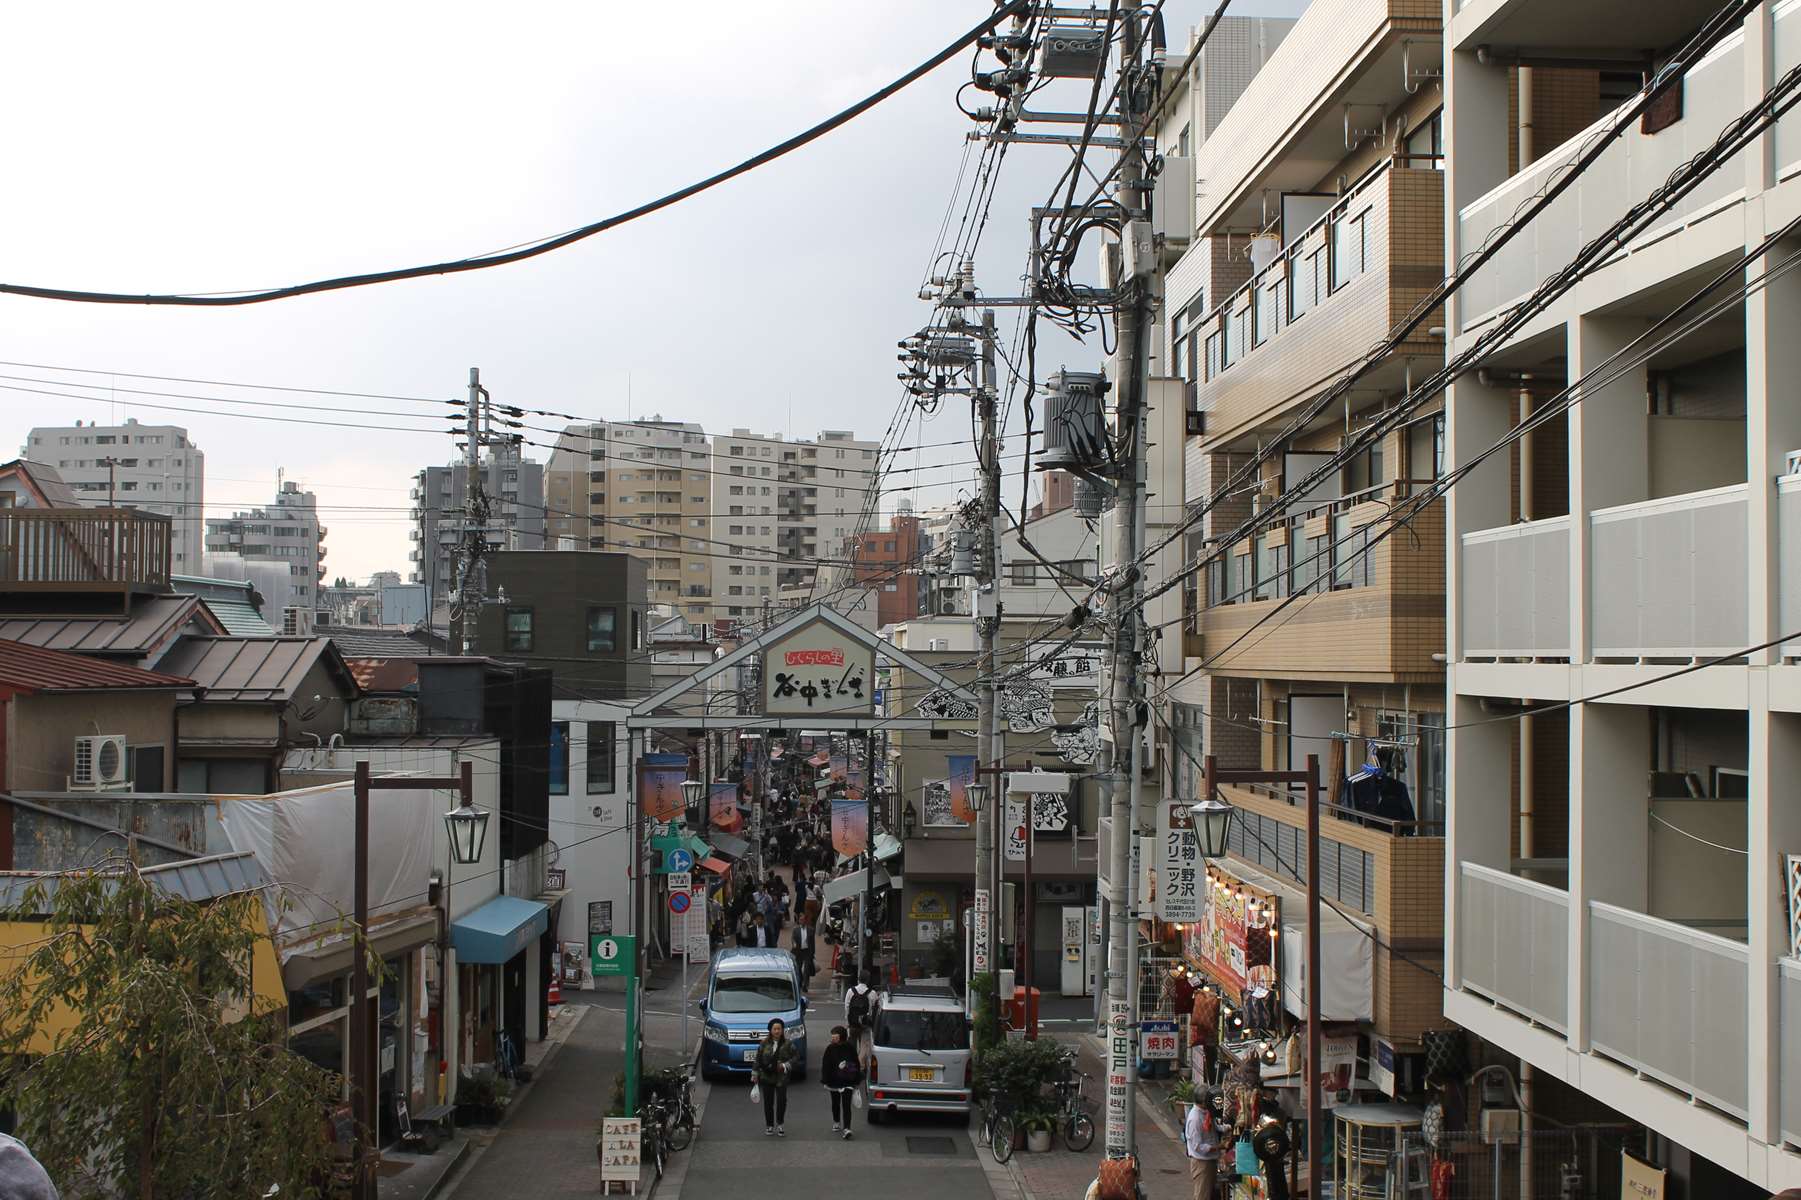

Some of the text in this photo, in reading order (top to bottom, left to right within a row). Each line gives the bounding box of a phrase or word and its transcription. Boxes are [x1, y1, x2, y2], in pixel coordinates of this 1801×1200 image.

[1167, 832, 1180, 896] クリニック
[1181, 832, 1195, 896] 動物・野沢
[1148, 1037, 1175, 1050] 焼肉
